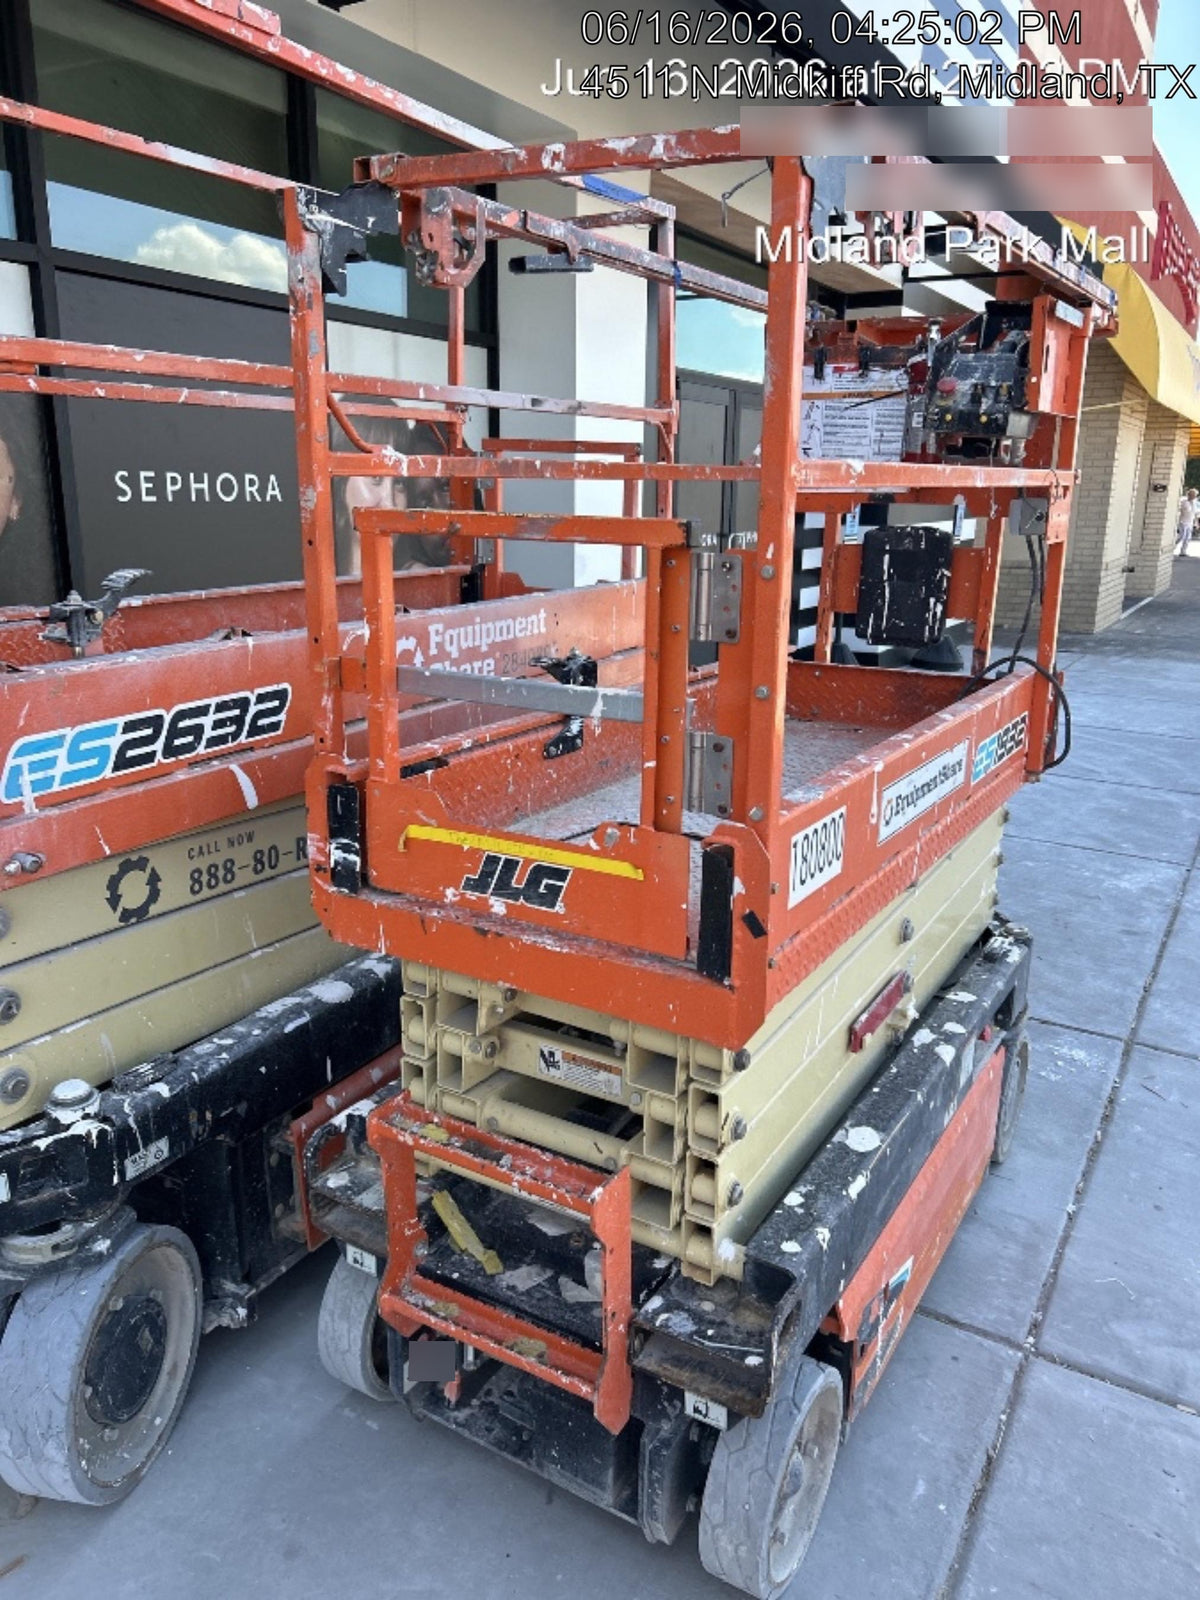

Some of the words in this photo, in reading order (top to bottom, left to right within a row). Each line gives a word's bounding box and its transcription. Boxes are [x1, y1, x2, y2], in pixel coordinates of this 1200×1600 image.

[114, 470, 283, 503] SEPHORA
[3, 684, 291, 803] ES2632
[187, 840, 221, 860] CALL
[227, 830, 255, 848] NOW
[189, 836, 308, 896] 888-80-R
[460, 852, 573, 913] JLG
